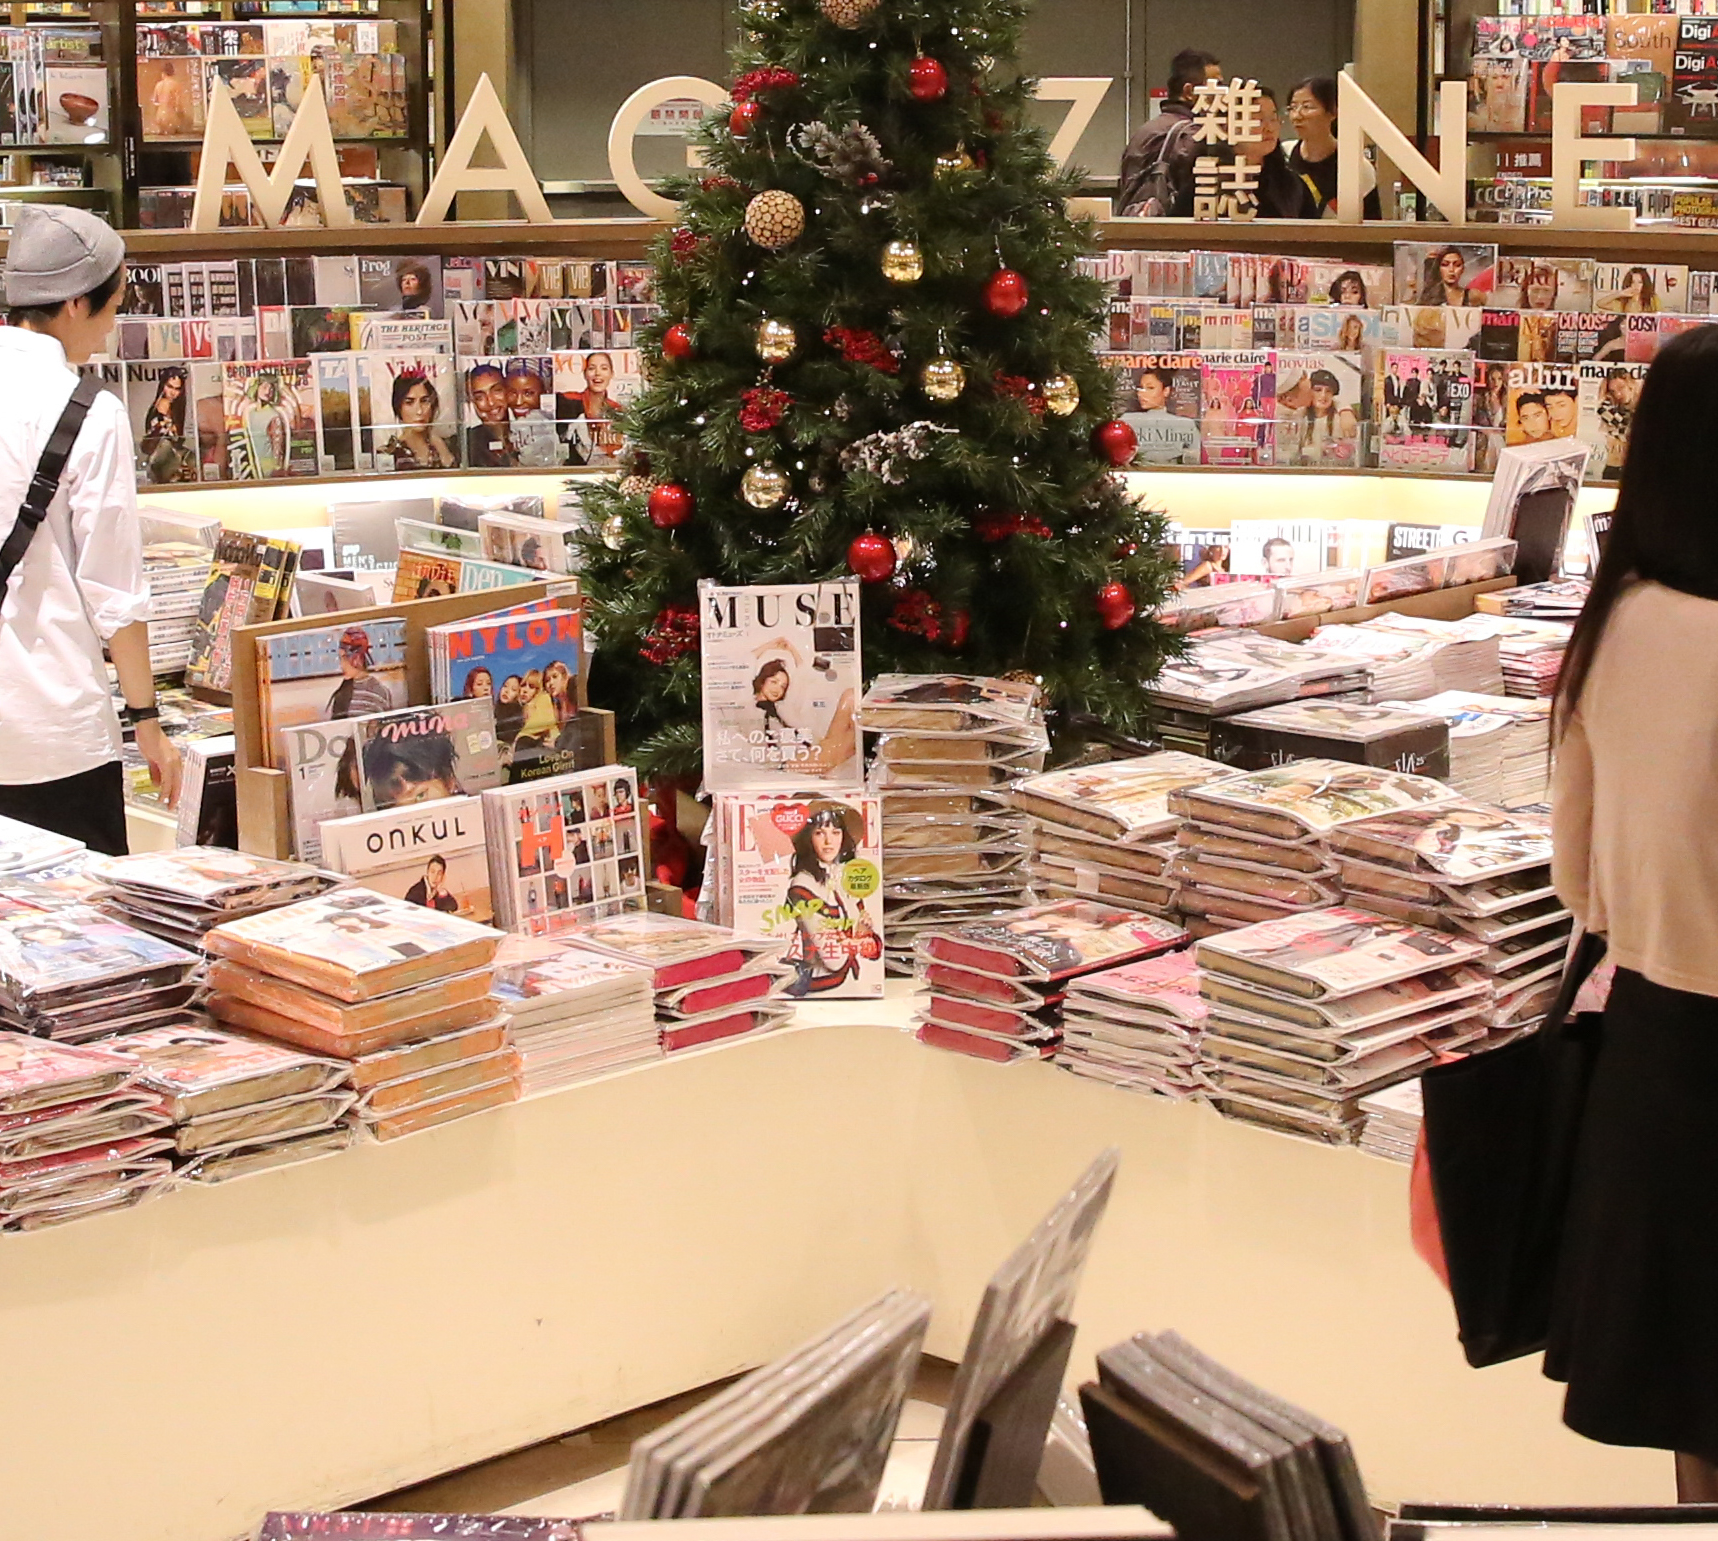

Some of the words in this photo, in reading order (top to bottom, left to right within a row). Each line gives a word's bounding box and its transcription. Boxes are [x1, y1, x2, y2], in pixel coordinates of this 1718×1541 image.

[1613, 31, 1672, 52] South
[1191, 76, 1263, 223] 雜誌
[361, 260, 391, 277] Frog
[380, 325, 399, 334] THE
[400, 323, 449, 333] HERITAGE
[401, 333, 429, 342] POST
[1116, 353, 1157, 370] marie
[1158, 352, 1203, 370] claire
[1233, 351, 1267, 365] claire
[1278, 356, 1325, 370] novias
[385, 359, 440, 381] Violet
[1450, 381, 1471, 400] EXO
[1155, 426, 1195, 445] Minaj
[461, 562, 504, 593] pen
[706, 592, 857, 629] MUSE
[448, 612, 580, 660] NYLON
[380, 712, 471, 745] mina
[715, 728, 814, 747] 私へのご褒美
[774, 813, 804, 824] GUCCI
